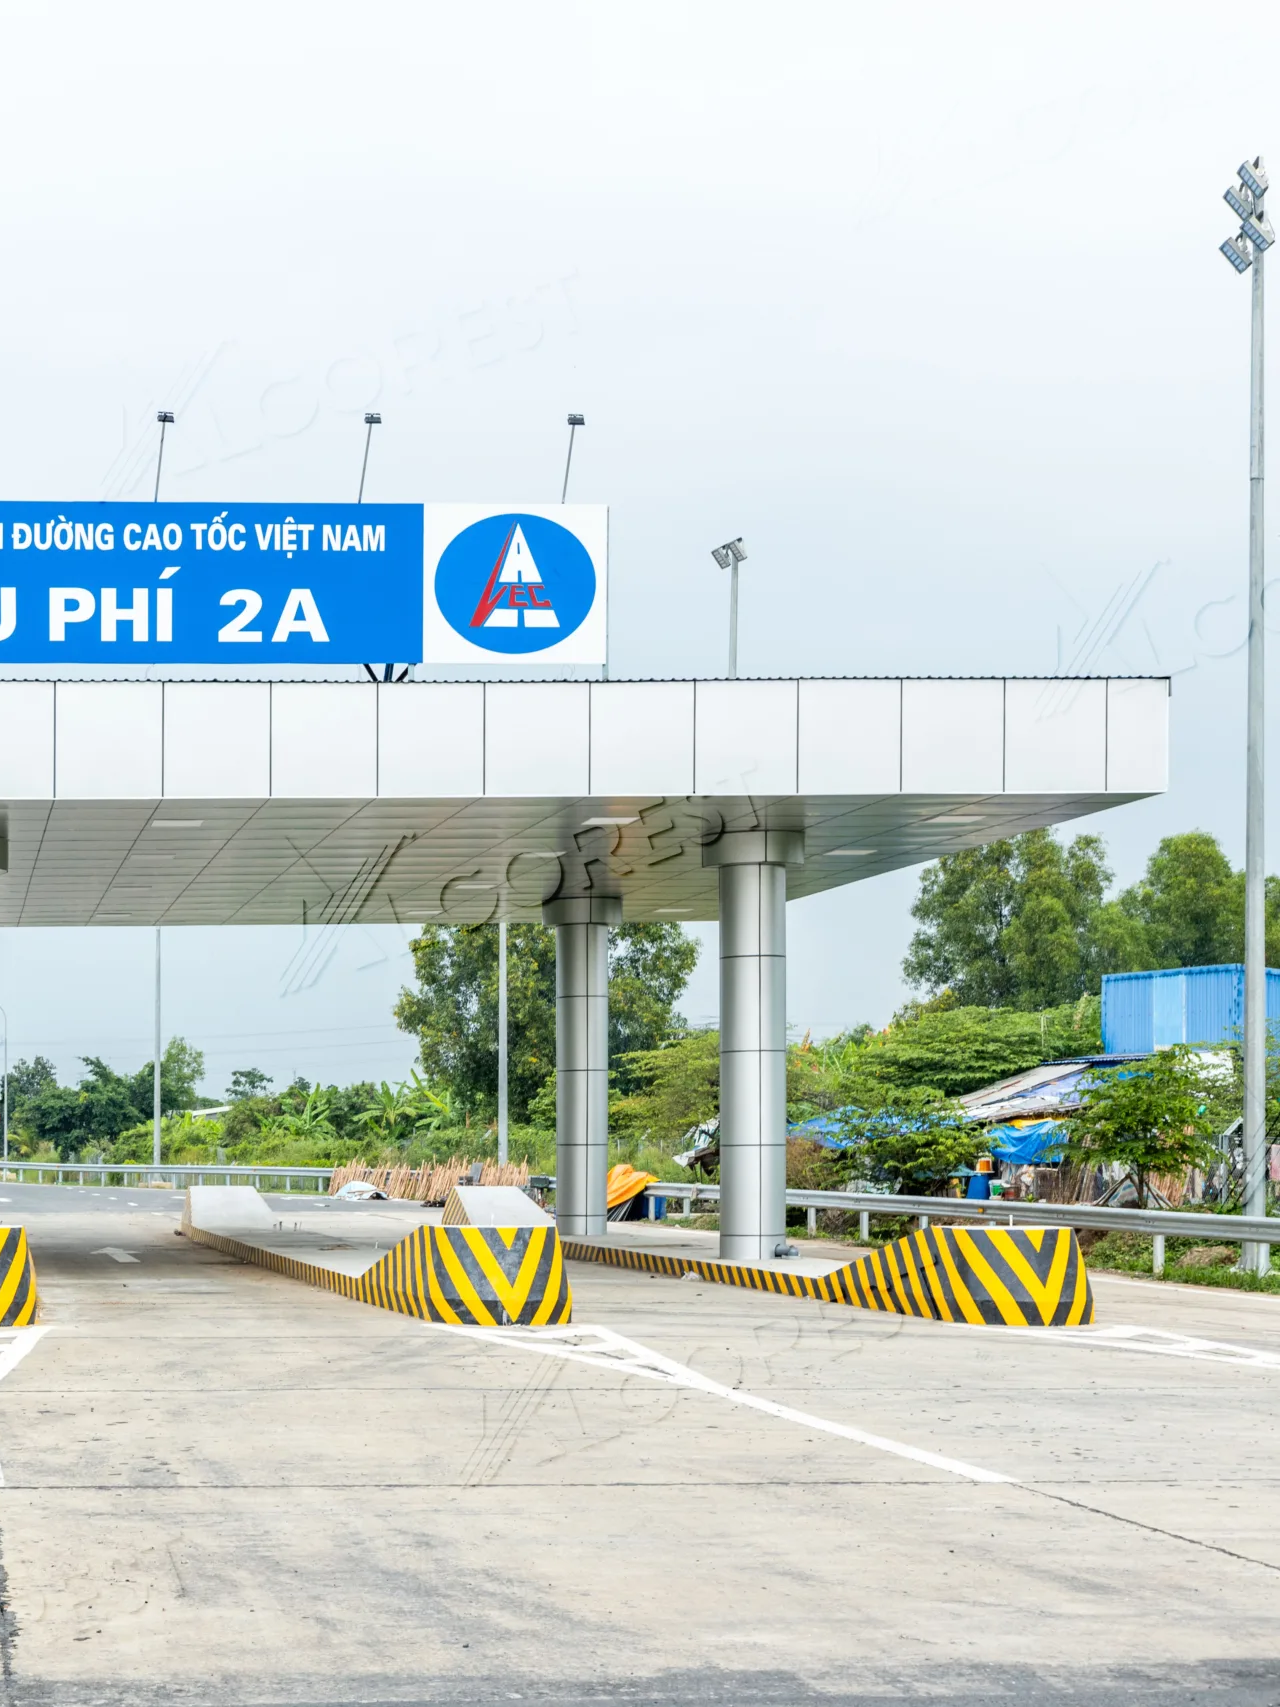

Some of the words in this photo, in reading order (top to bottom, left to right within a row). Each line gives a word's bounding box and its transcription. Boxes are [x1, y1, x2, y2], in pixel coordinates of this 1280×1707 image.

[12, 516, 114, 551] ĐƯỜNG
[124, 522, 182, 551] CAO
[191, 511, 246, 551] TỐC
[255, 517, 314, 559] VIỆT
[323, 524, 386, 552] NAM
[49, 566, 181, 643] PHÍ
[217, 588, 330, 643] 2A
